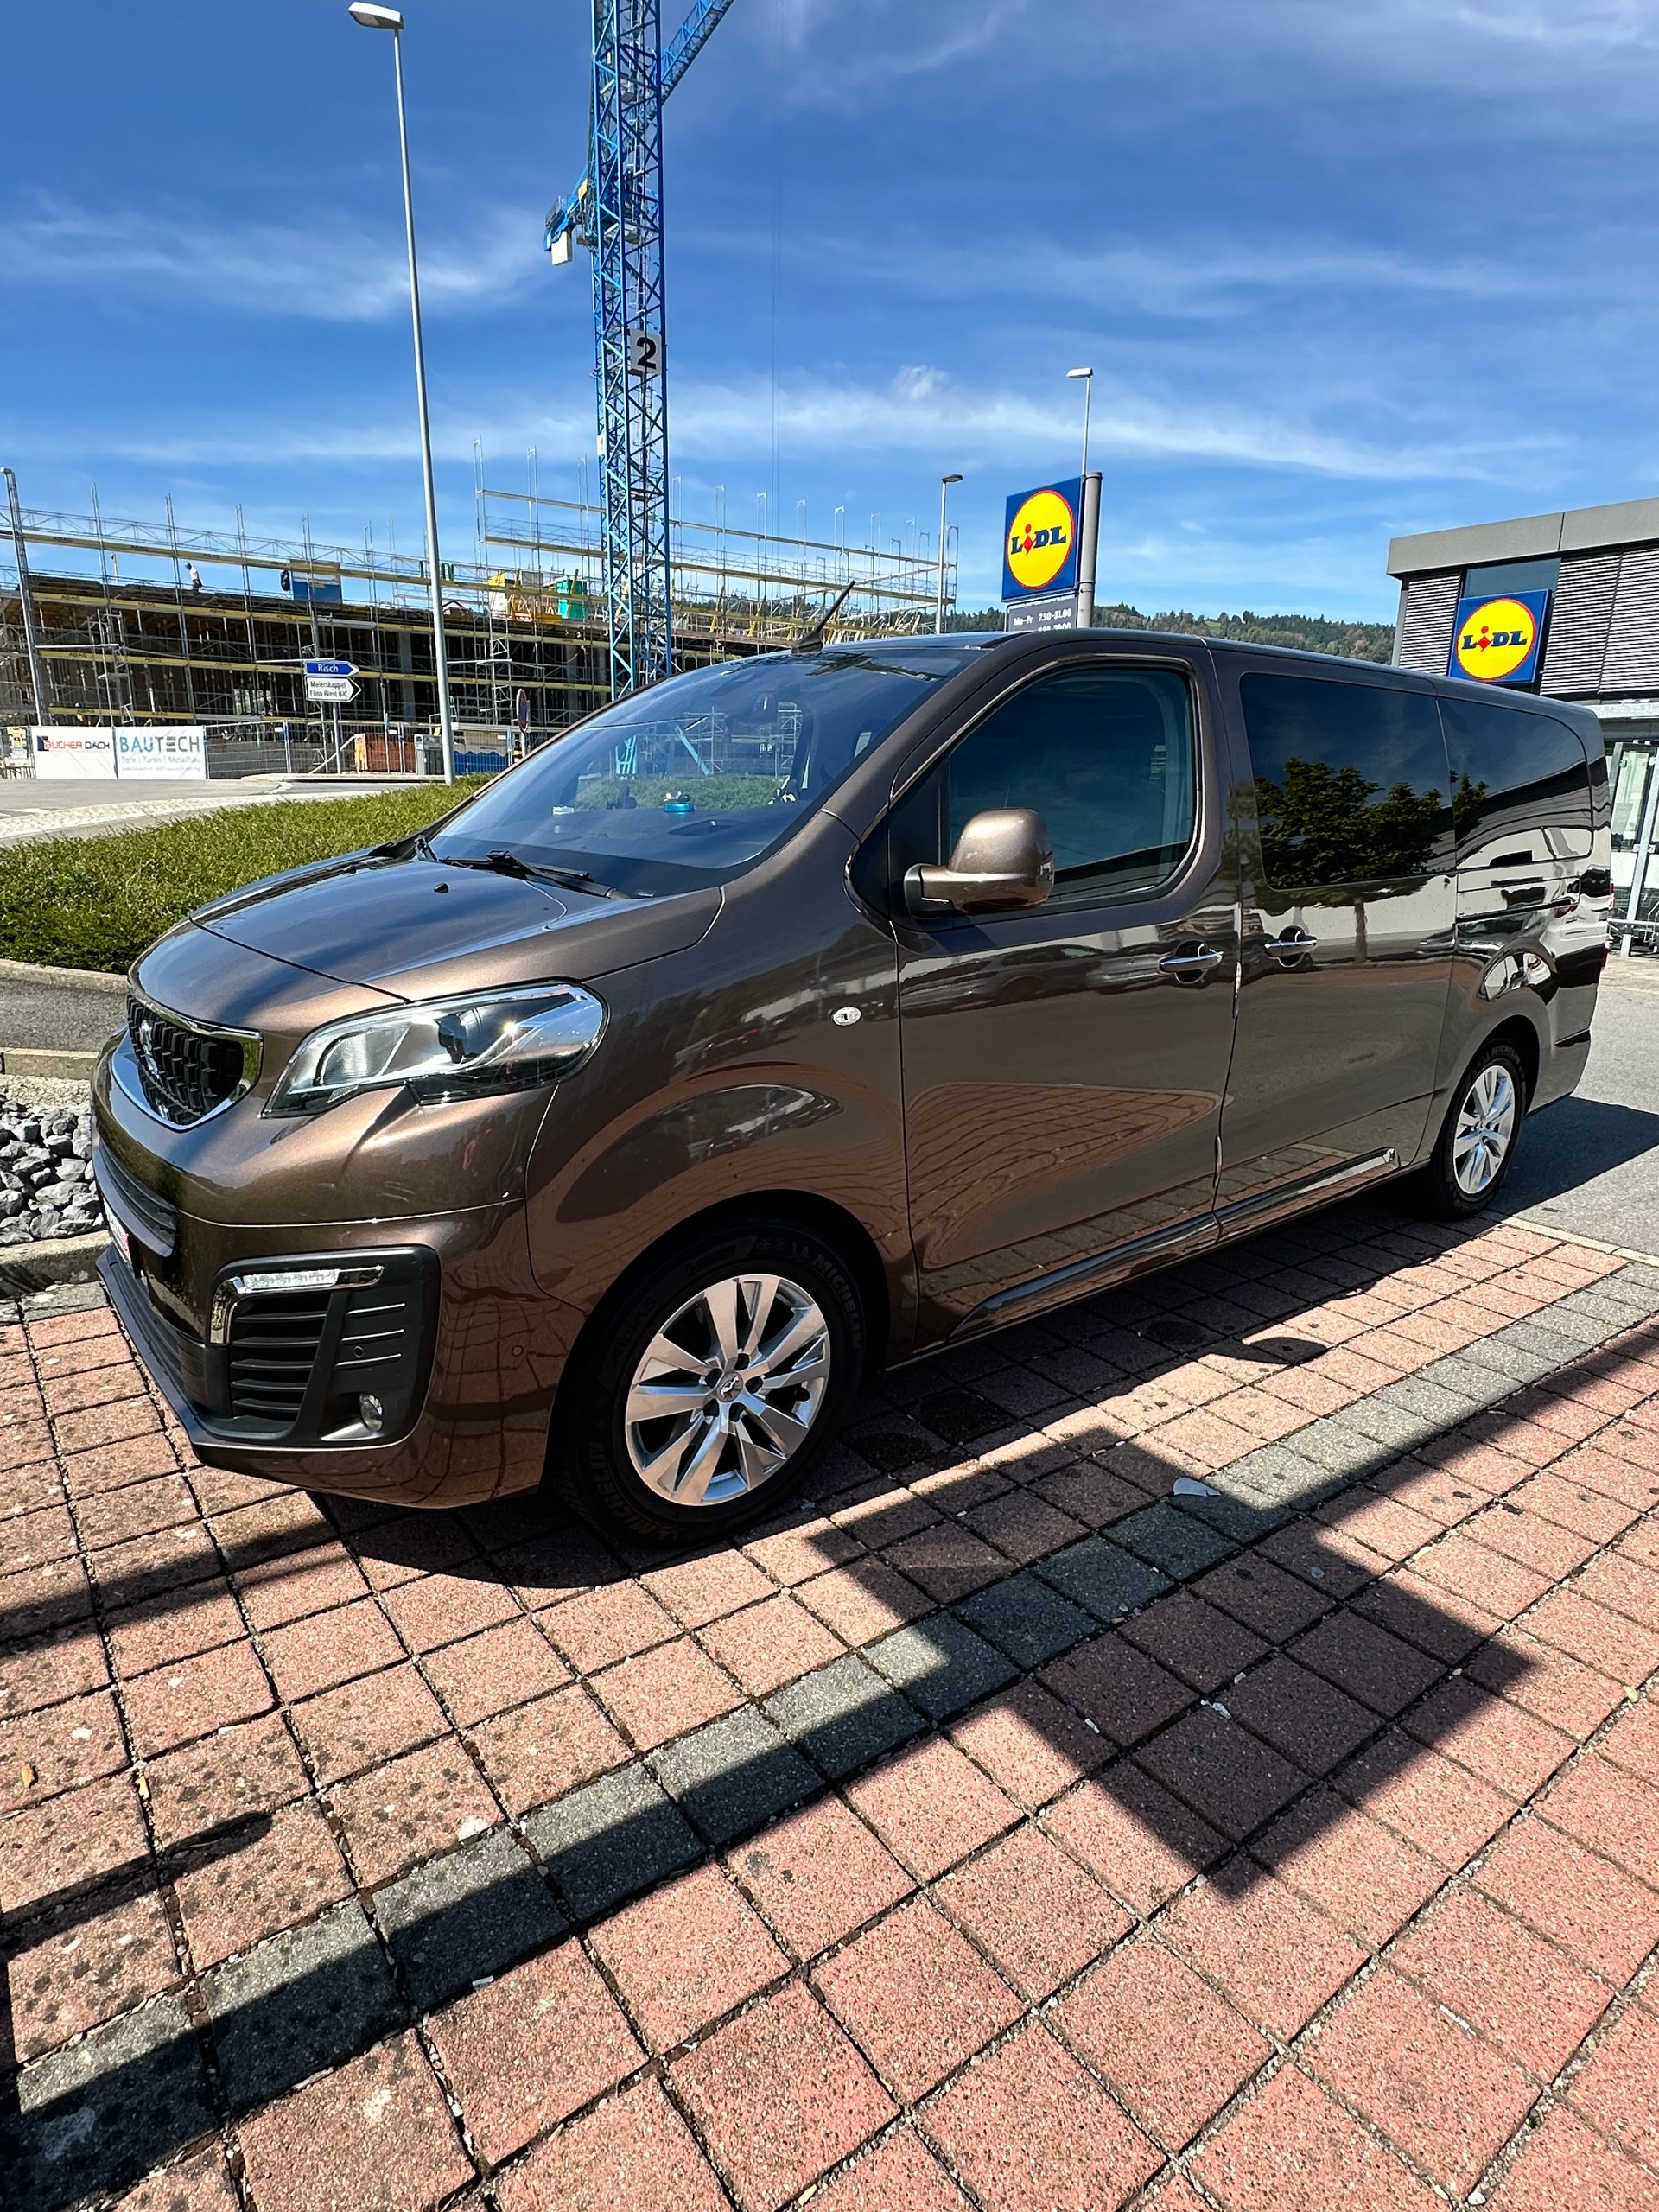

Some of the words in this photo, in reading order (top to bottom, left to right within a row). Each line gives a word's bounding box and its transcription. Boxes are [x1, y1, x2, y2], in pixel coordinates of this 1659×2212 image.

[637, 336, 657, 370] 2
[317, 664, 339, 673] Risch
[85, 741, 110, 750] DACH
[119, 735, 200, 753] BAUTECH
[810, 1253, 862, 1350] MICHELIN
[587, 1440, 660, 1536] MICHELIN
